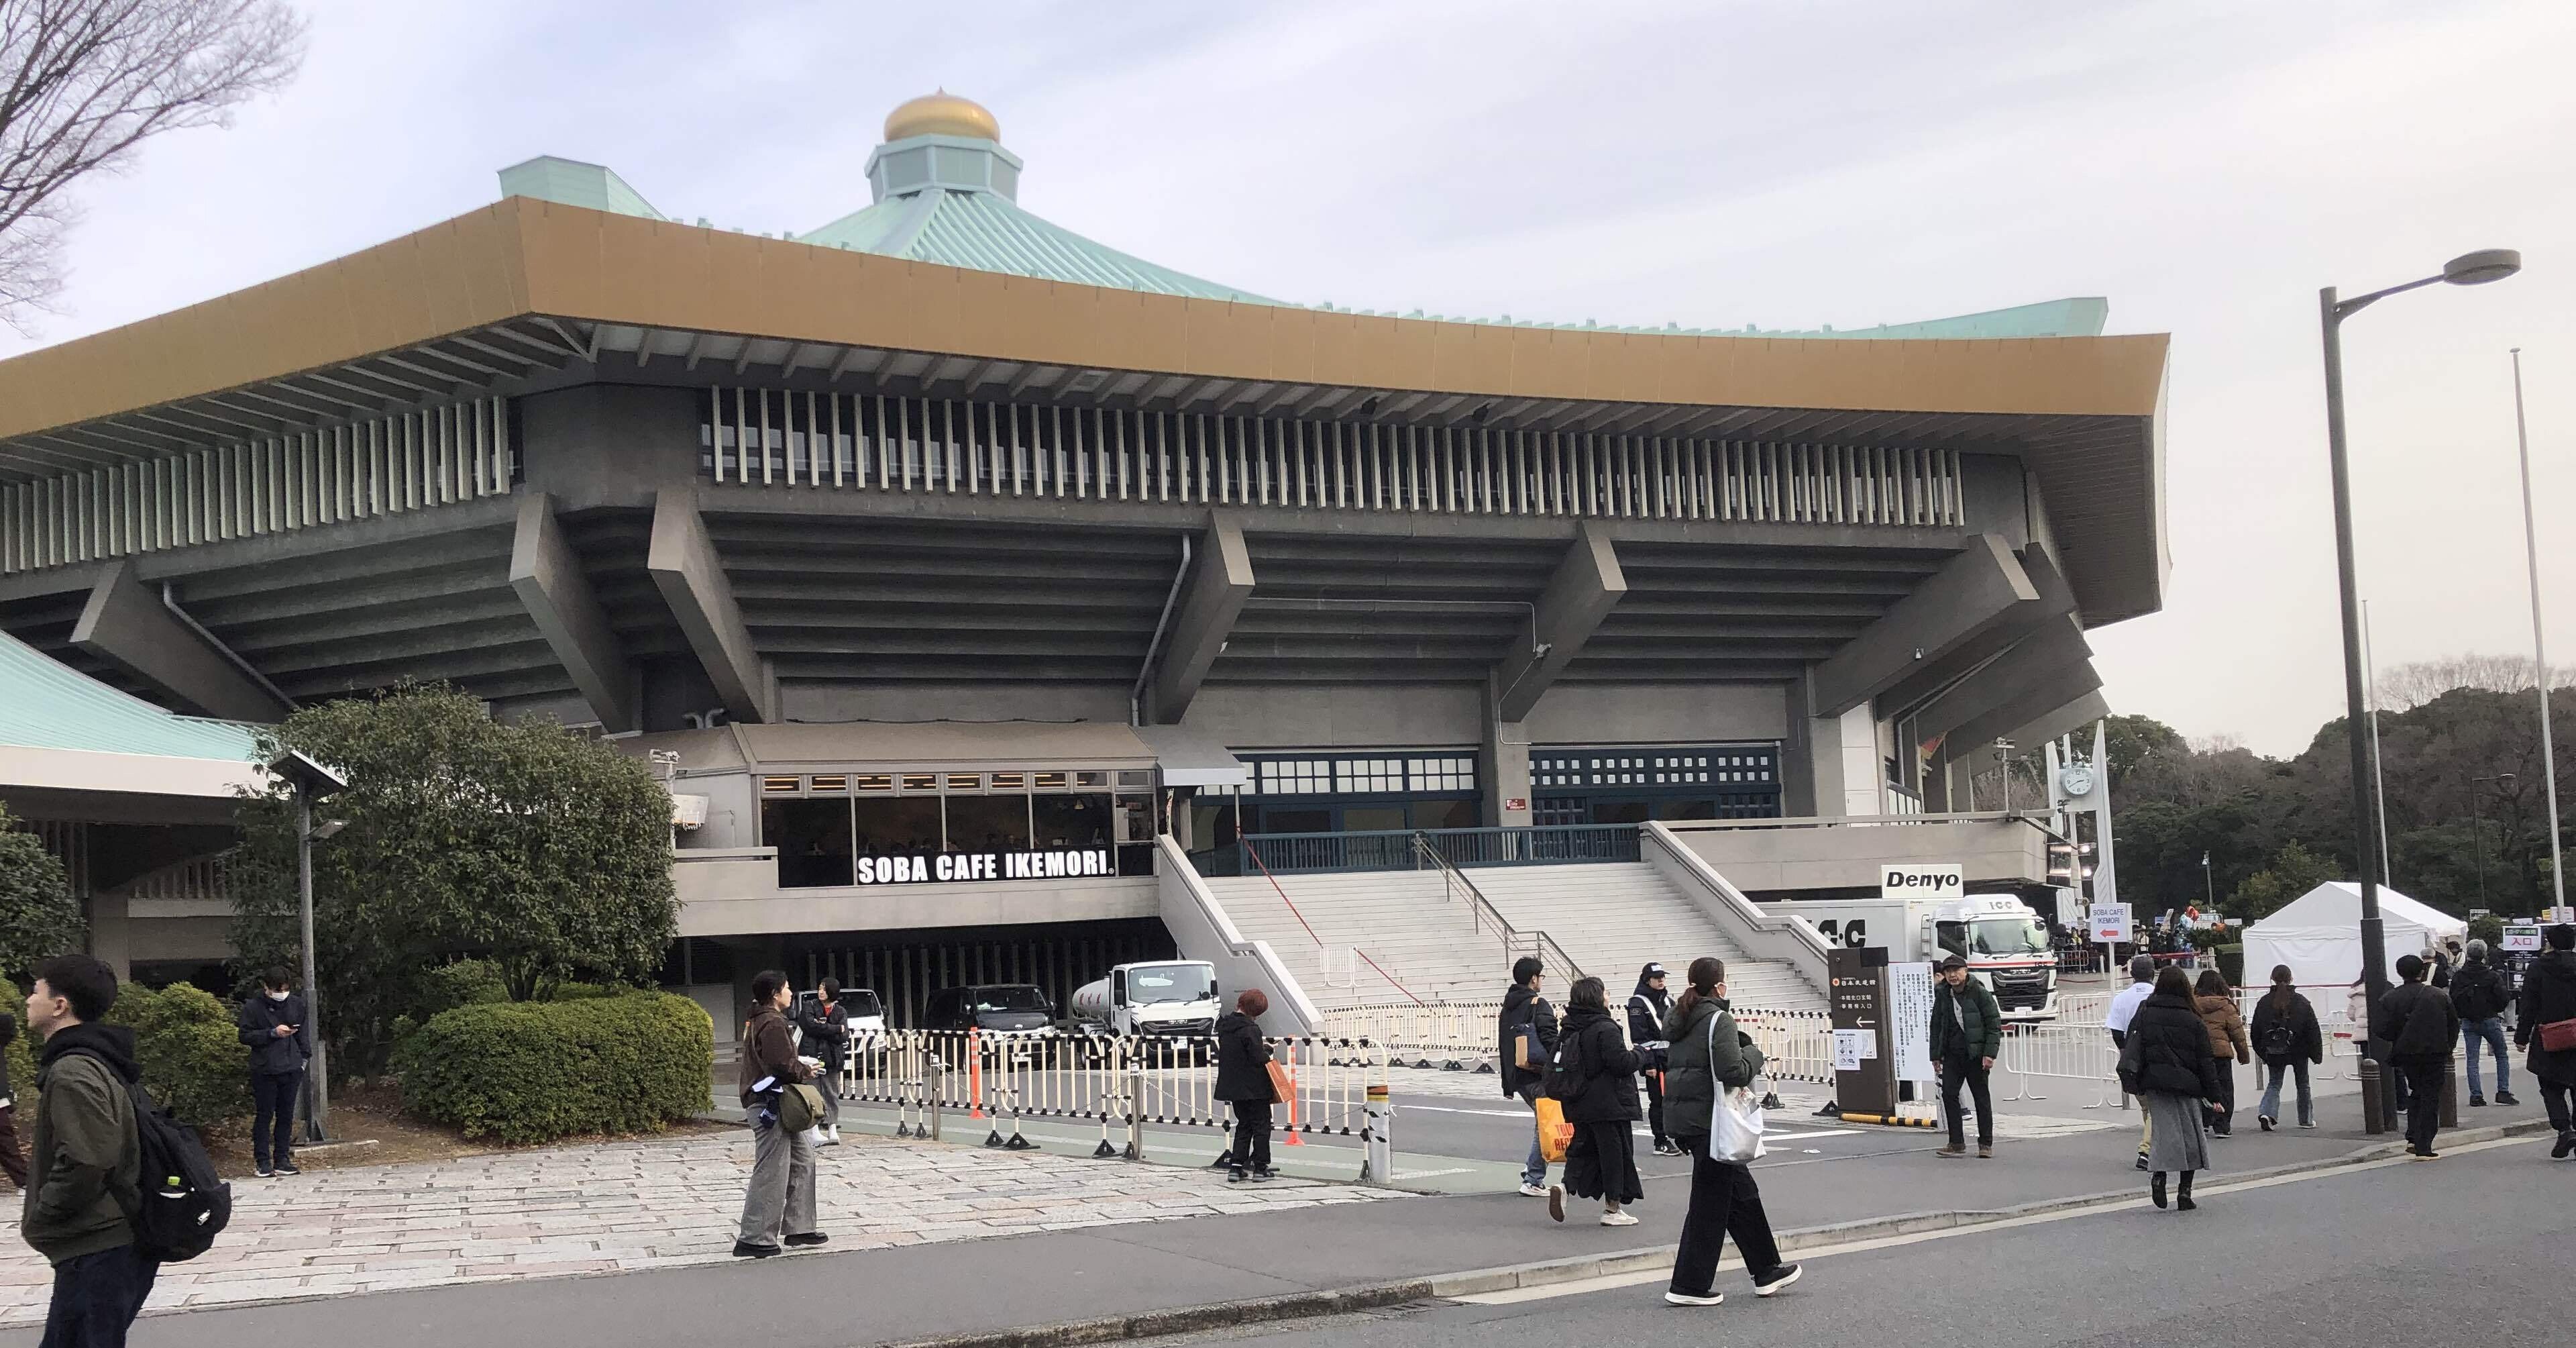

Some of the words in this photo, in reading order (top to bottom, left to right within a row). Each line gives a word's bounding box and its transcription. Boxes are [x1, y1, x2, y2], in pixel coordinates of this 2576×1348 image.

[858, 856, 928, 884] SOBA
[936, 853, 997, 880] CAFE
[1005, 850, 1107, 878] IKEMORI
[1886, 872, 1960, 892] Denyo
[2512, 937, 2532, 946] 入口
